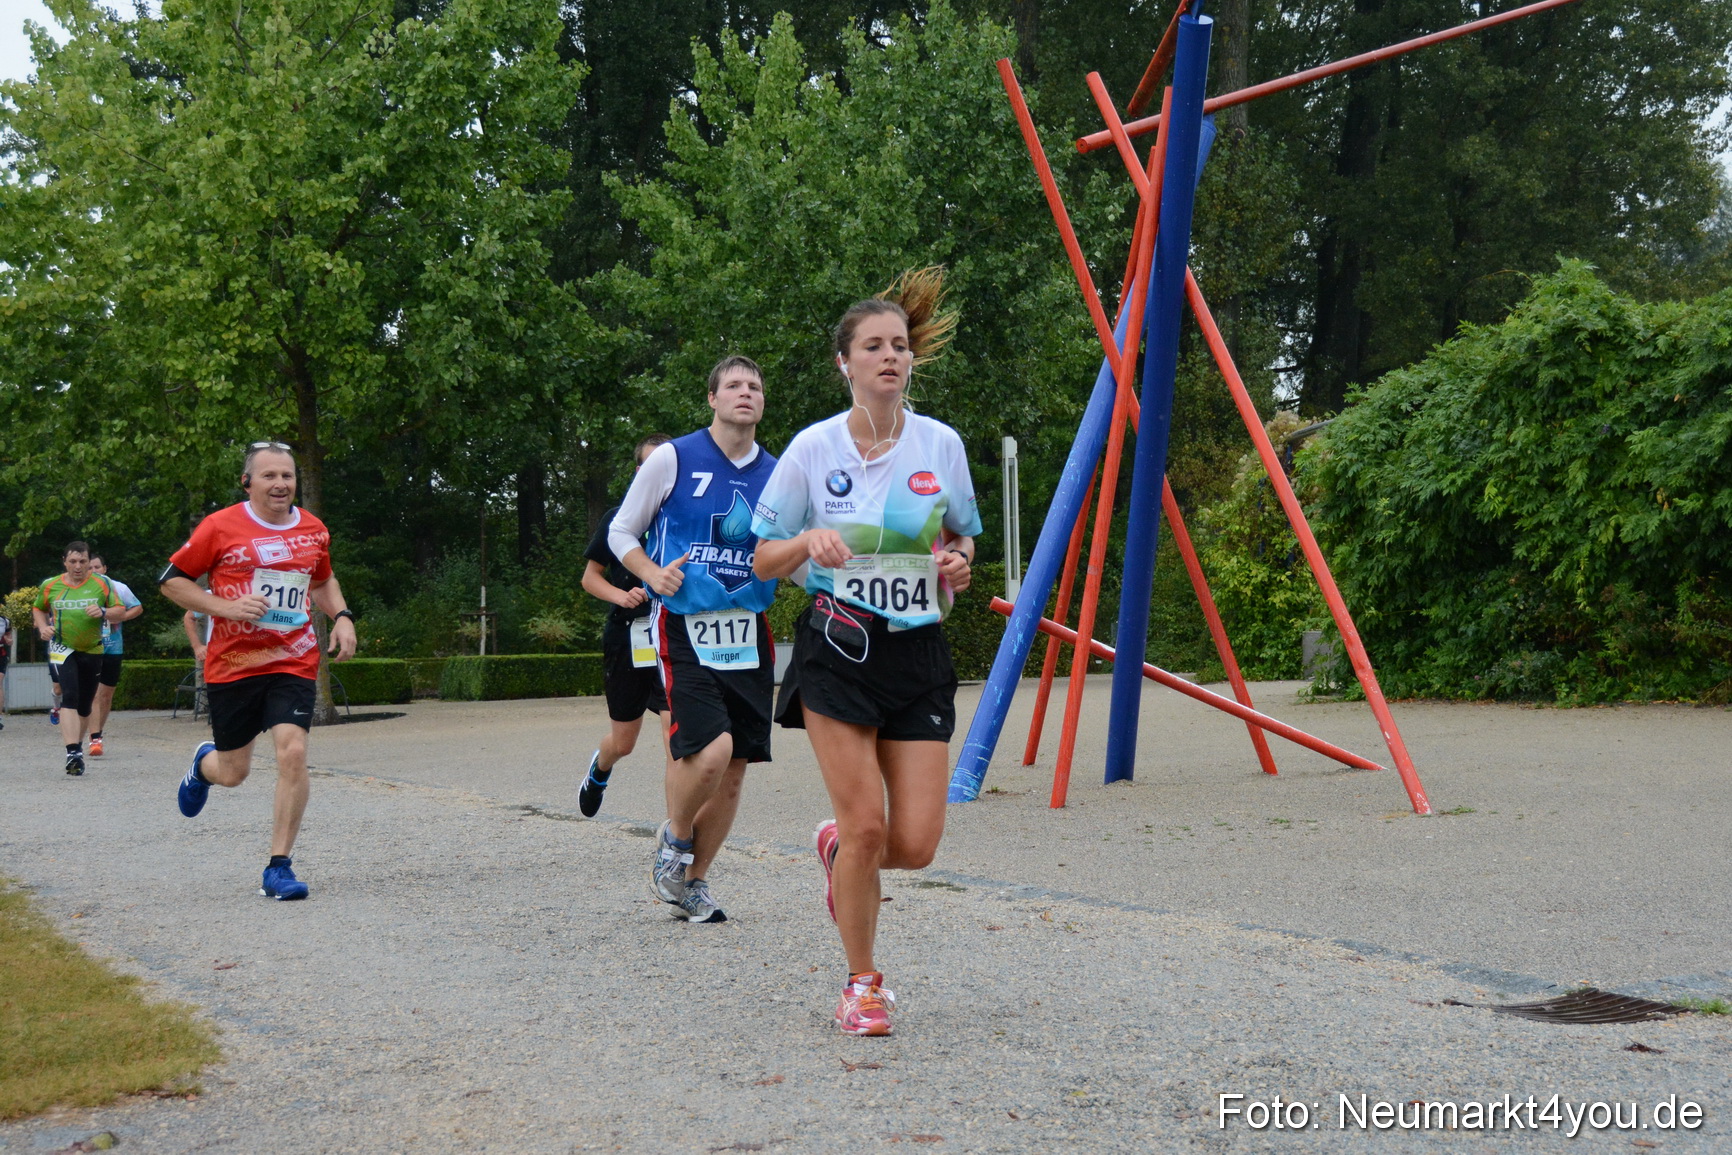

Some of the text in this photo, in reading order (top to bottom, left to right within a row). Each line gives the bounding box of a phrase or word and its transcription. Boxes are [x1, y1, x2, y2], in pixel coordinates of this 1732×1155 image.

[691, 472, 713, 497] 7
[825, 501, 856, 509] PARTL
[882, 557, 929, 568] BOCK
[261, 583, 305, 610] 2101
[846, 577, 929, 612] 3064
[272, 613, 293, 624] Hans
[694, 618, 750, 645] 2117
[711, 652, 740, 663] Jürgen
